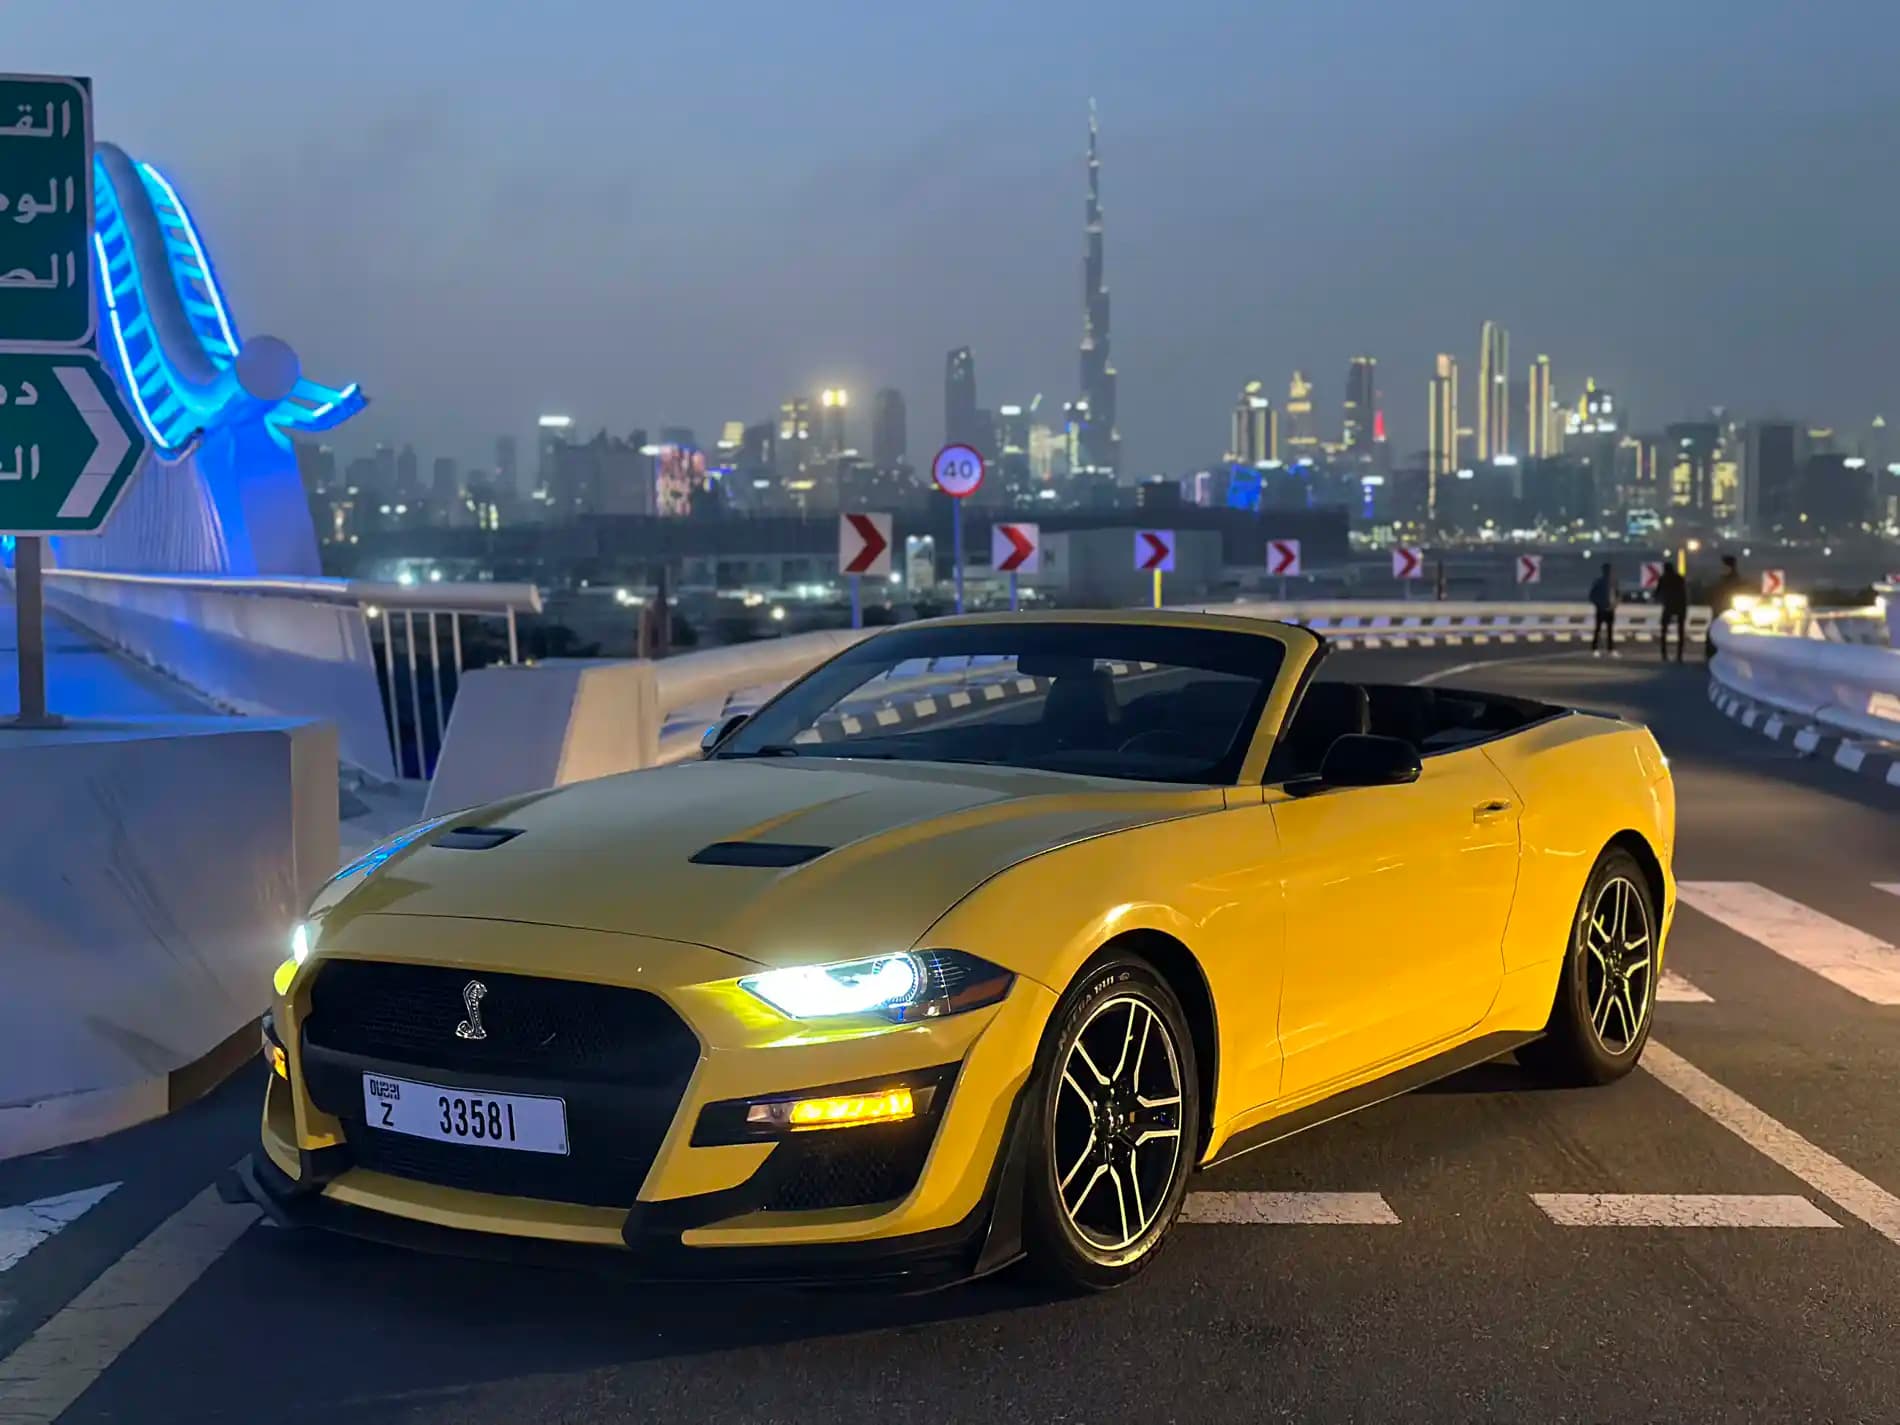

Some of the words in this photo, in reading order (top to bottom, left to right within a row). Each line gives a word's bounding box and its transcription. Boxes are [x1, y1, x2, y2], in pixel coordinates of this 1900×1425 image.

[943, 460, 973, 479] 40
[381, 1102, 394, 1127] Z
[438, 1096, 516, 1142] 33581
